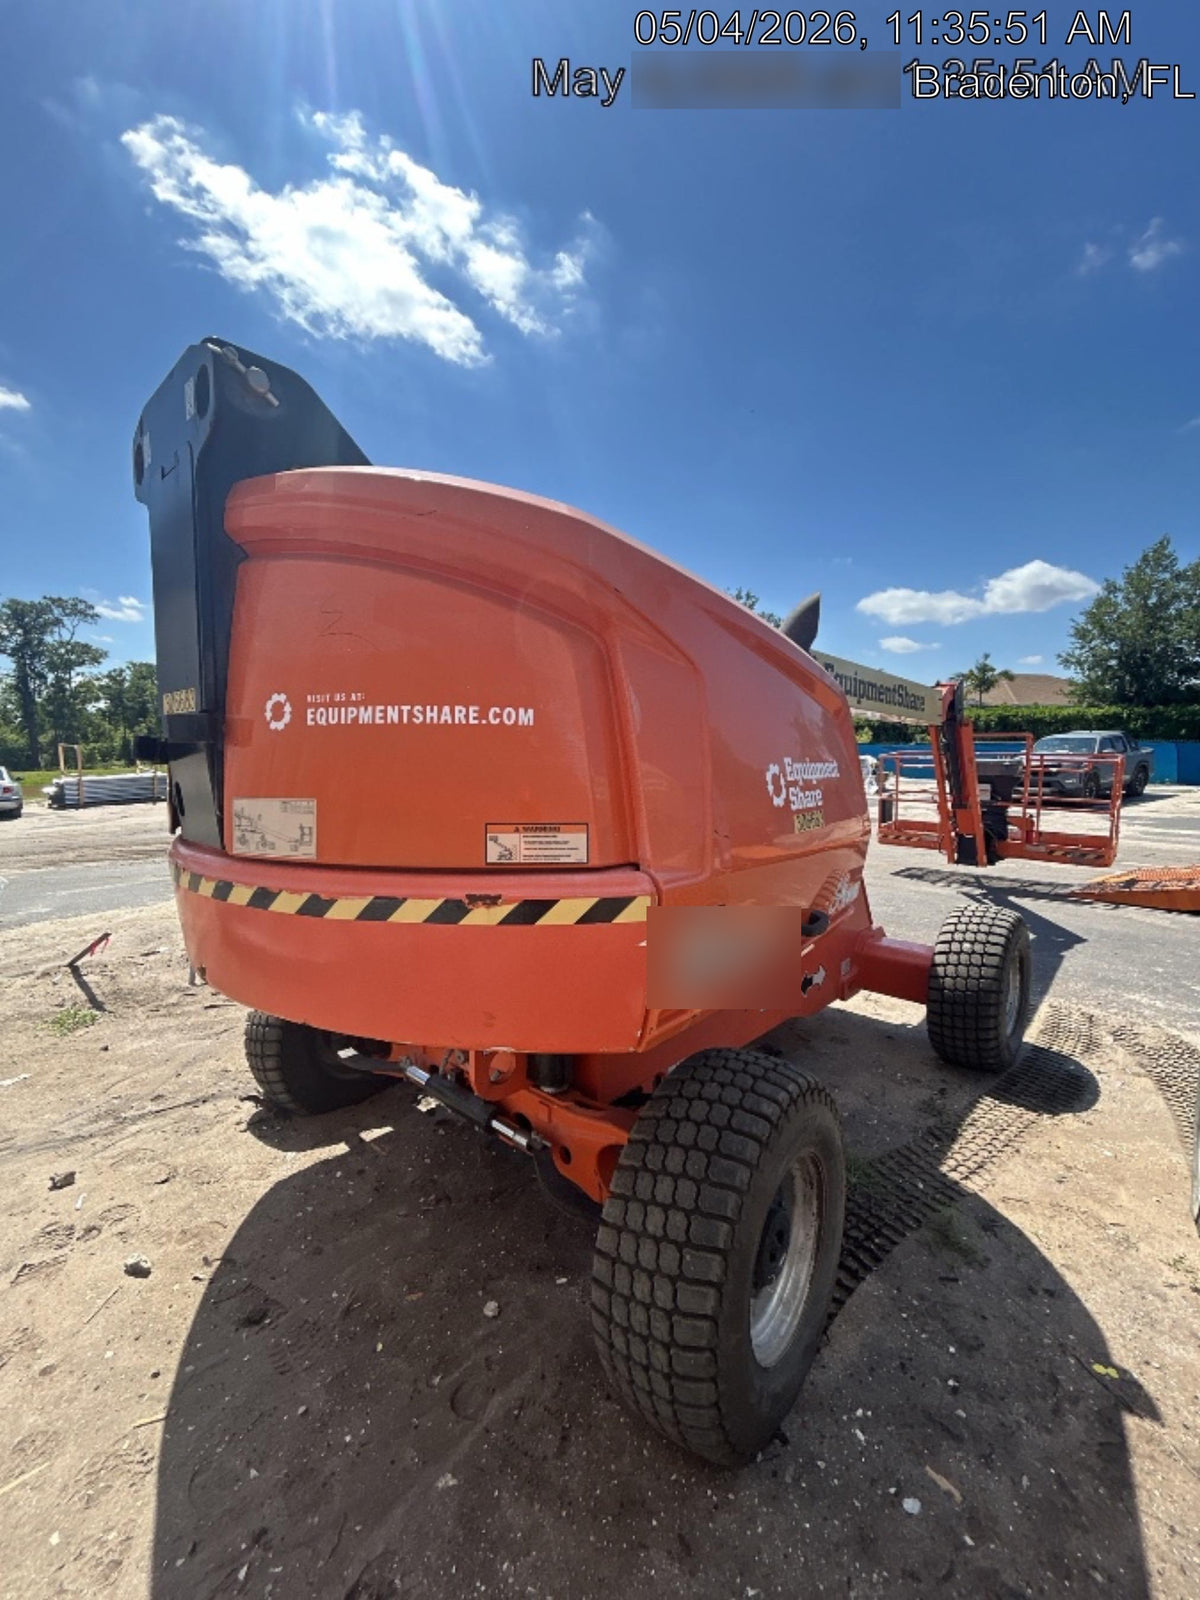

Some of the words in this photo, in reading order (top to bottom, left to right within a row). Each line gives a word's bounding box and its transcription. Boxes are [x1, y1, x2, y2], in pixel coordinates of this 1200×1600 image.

[334, 692, 346, 702] US
[306, 703, 535, 727] EQUIPMENTSHARE.COM
[784, 757, 840, 785] Equipment
[789, 786, 823, 812] Share
